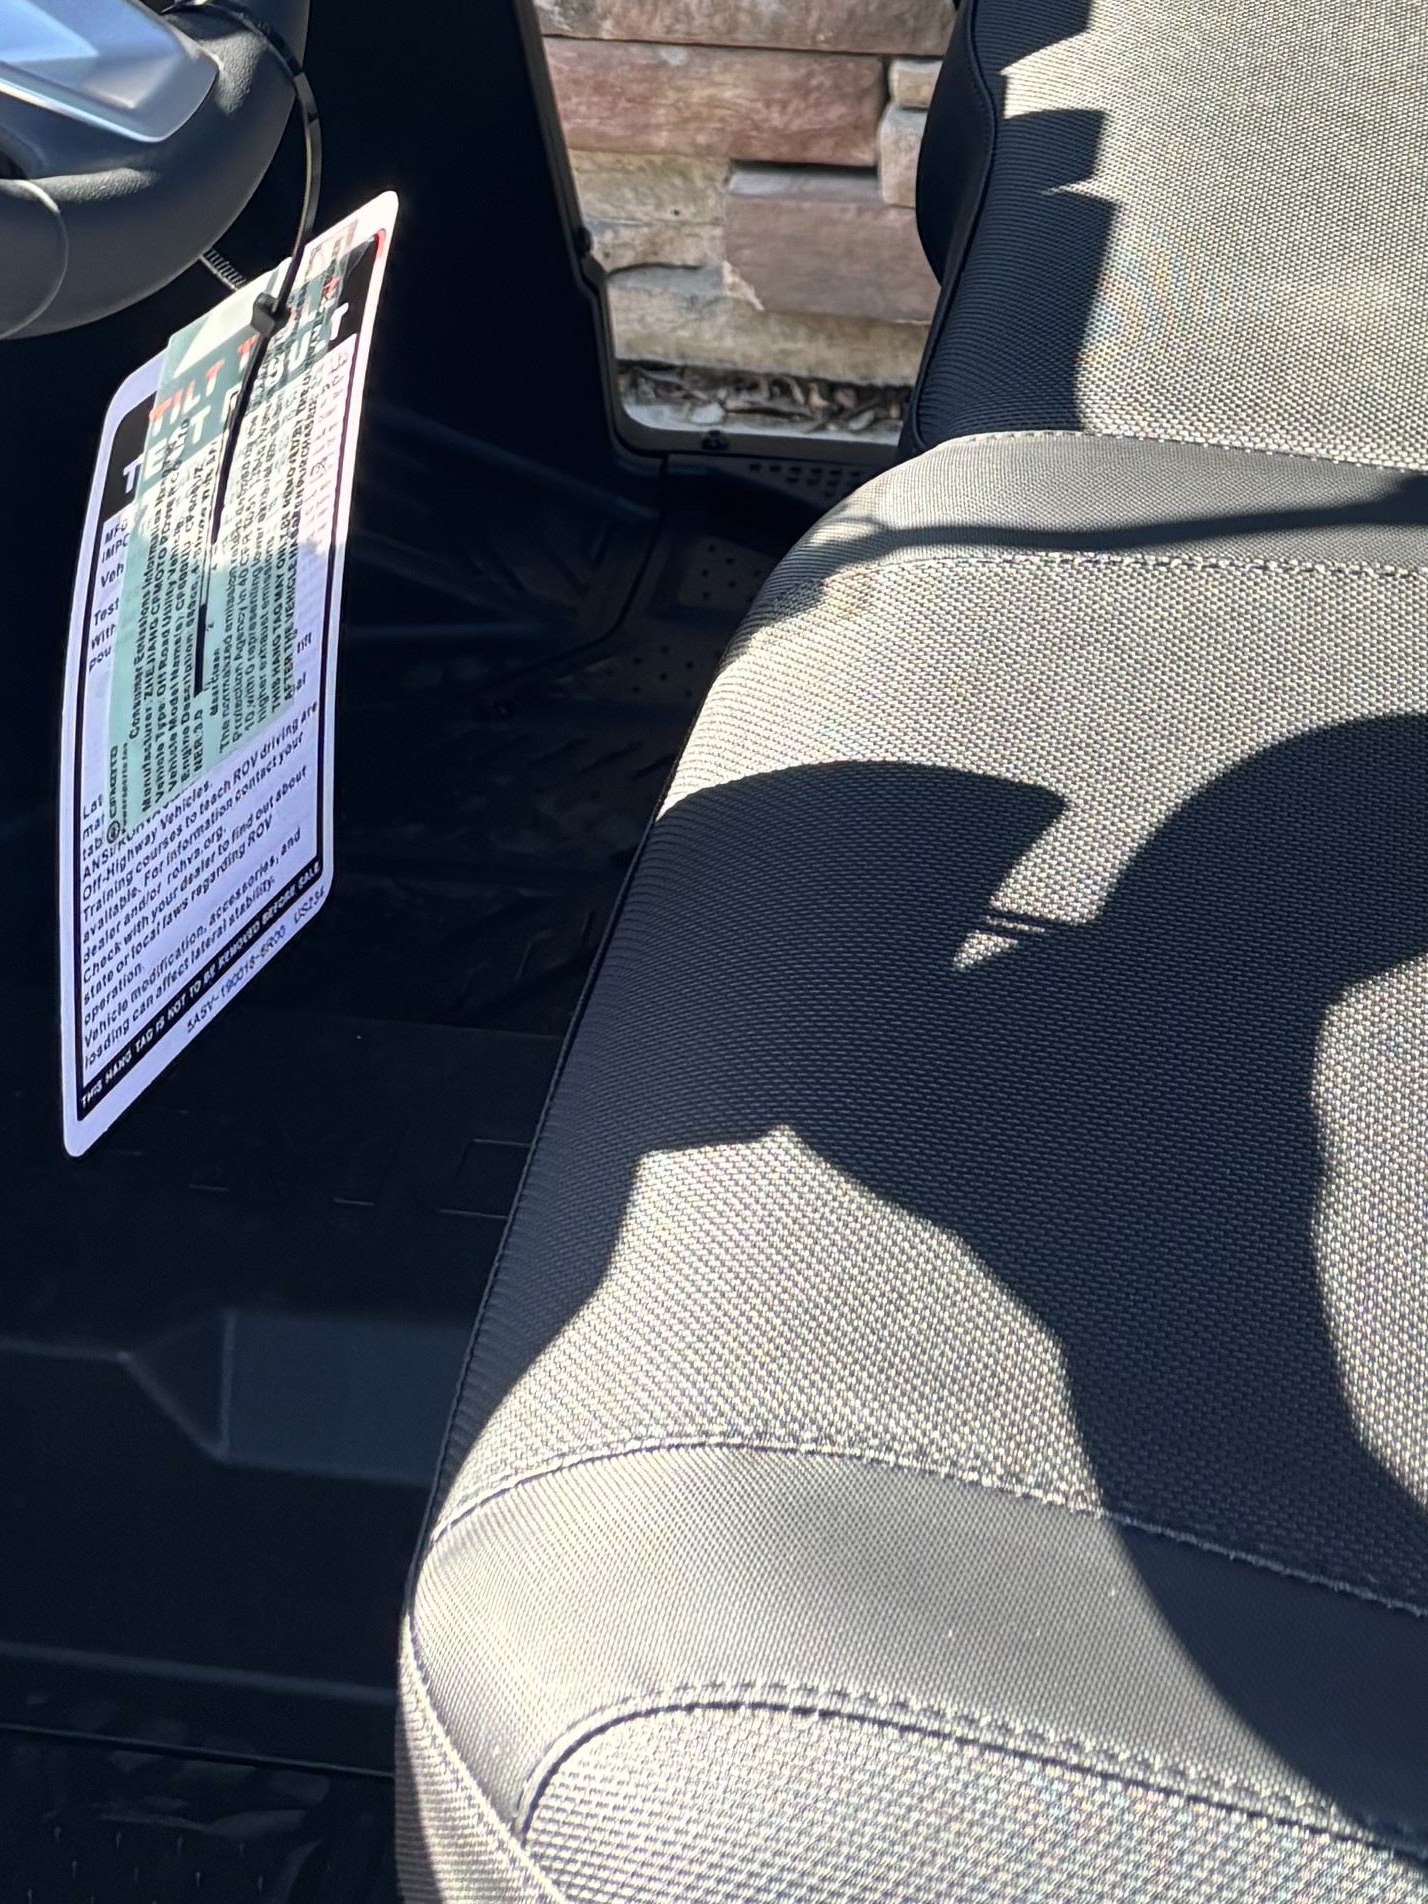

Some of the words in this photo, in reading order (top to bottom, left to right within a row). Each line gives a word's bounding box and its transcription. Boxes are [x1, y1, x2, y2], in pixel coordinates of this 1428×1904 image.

[149, 358, 225, 437] TILT
[271, 631, 282, 678] HANG
[284, 557, 297, 624] VEHICLE
[82, 820, 157, 905] Off-Highway
[83, 863, 133, 925] Training
[135, 818, 182, 876] courses
[185, 806, 197, 831] to
[199, 775, 231, 817] teach
[232, 749, 258, 786] ROV
[260, 715, 298, 762] driving
[300, 699, 317, 725] are
[83, 936, 121, 987] Check
[123, 910, 149, 949] with
[151, 883, 178, 925] your
[180, 847, 215, 894] dealer
[218, 835, 230, 859] to
[231, 811, 253, 846] find
[255, 793, 274, 823] out
[275, 762, 307, 804] about
[143, 857, 164, 889] For
[166, 794, 232, 868] information
[234, 753, 276, 804] contact
[278, 731, 303, 767] your
[81, 1076, 102, 1110] THIS
[105, 1047, 131, 1085] HANG
[135, 1025, 153, 1055] TAG
[168, 991, 186, 1022] NOT
[217, 918, 259, 971] REMOVED
[262, 882, 295, 927] BEFORE
[298, 858, 319, 890] SALE
[83, 963, 114, 1008] state
[162, 892, 188, 931] laws
[190, 837, 246, 904] regarding
[247, 812, 272, 850] ROV
[83, 916, 121, 966] dealer
[84, 993, 128, 1051] Vehicle
[281, 825, 300, 857] and
[84, 1013, 129, 1074] loading
[132, 991, 153, 1024] can
[155, 951, 189, 1001] affect
[190, 915, 226, 964] lateral
